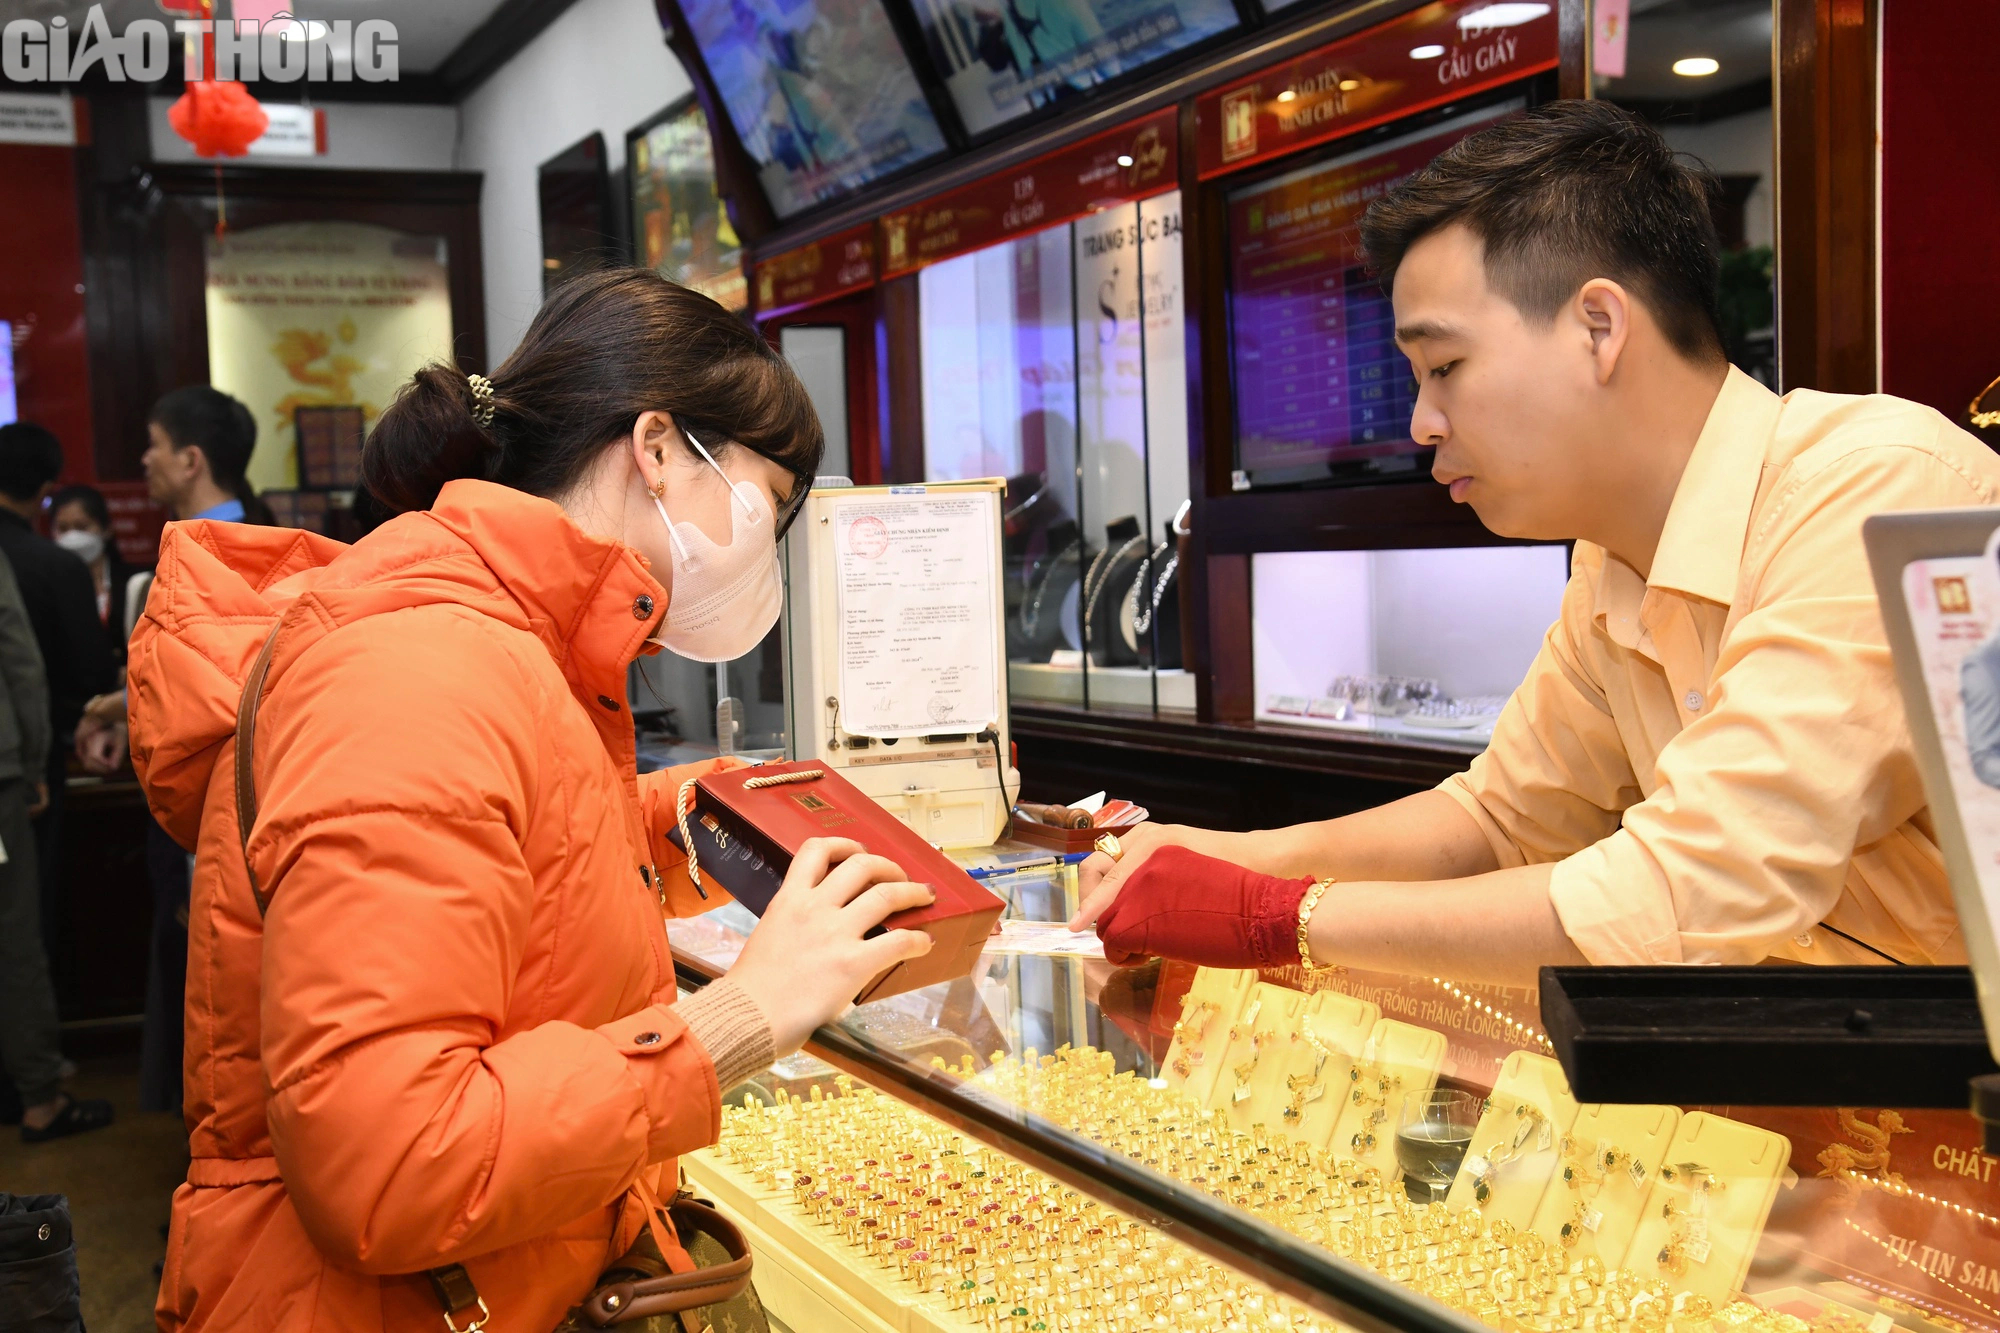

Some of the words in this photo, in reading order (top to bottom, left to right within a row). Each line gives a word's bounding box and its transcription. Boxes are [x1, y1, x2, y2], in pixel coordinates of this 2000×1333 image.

[1475, 28, 1518, 72] GIẤY
[1083, 228, 1124, 258] TRANG
[1162, 213, 1183, 241] BẠ
[1464, 1012, 1502, 1041] LONG
[1933, 1143, 1998, 1184] CHẤT
[1921, 1244, 1957, 1279] TIN
